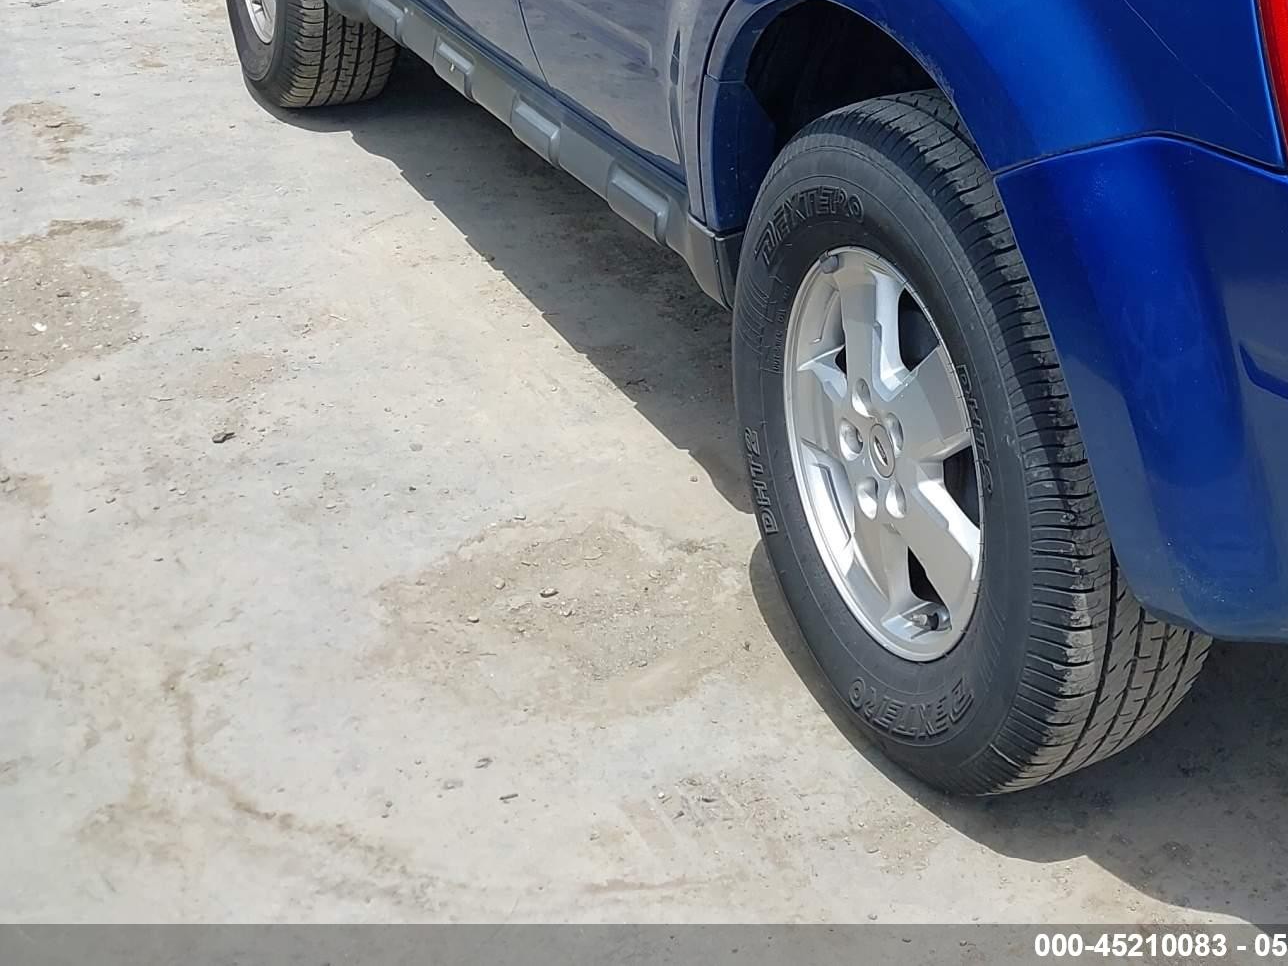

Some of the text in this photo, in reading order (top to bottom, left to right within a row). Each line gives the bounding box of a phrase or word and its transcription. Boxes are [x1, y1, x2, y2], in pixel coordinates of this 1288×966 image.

[755, 185, 864, 266] DEXTERO
[744, 426, 779, 534] DHT2
[848, 676, 974, 738] DEXTERO
